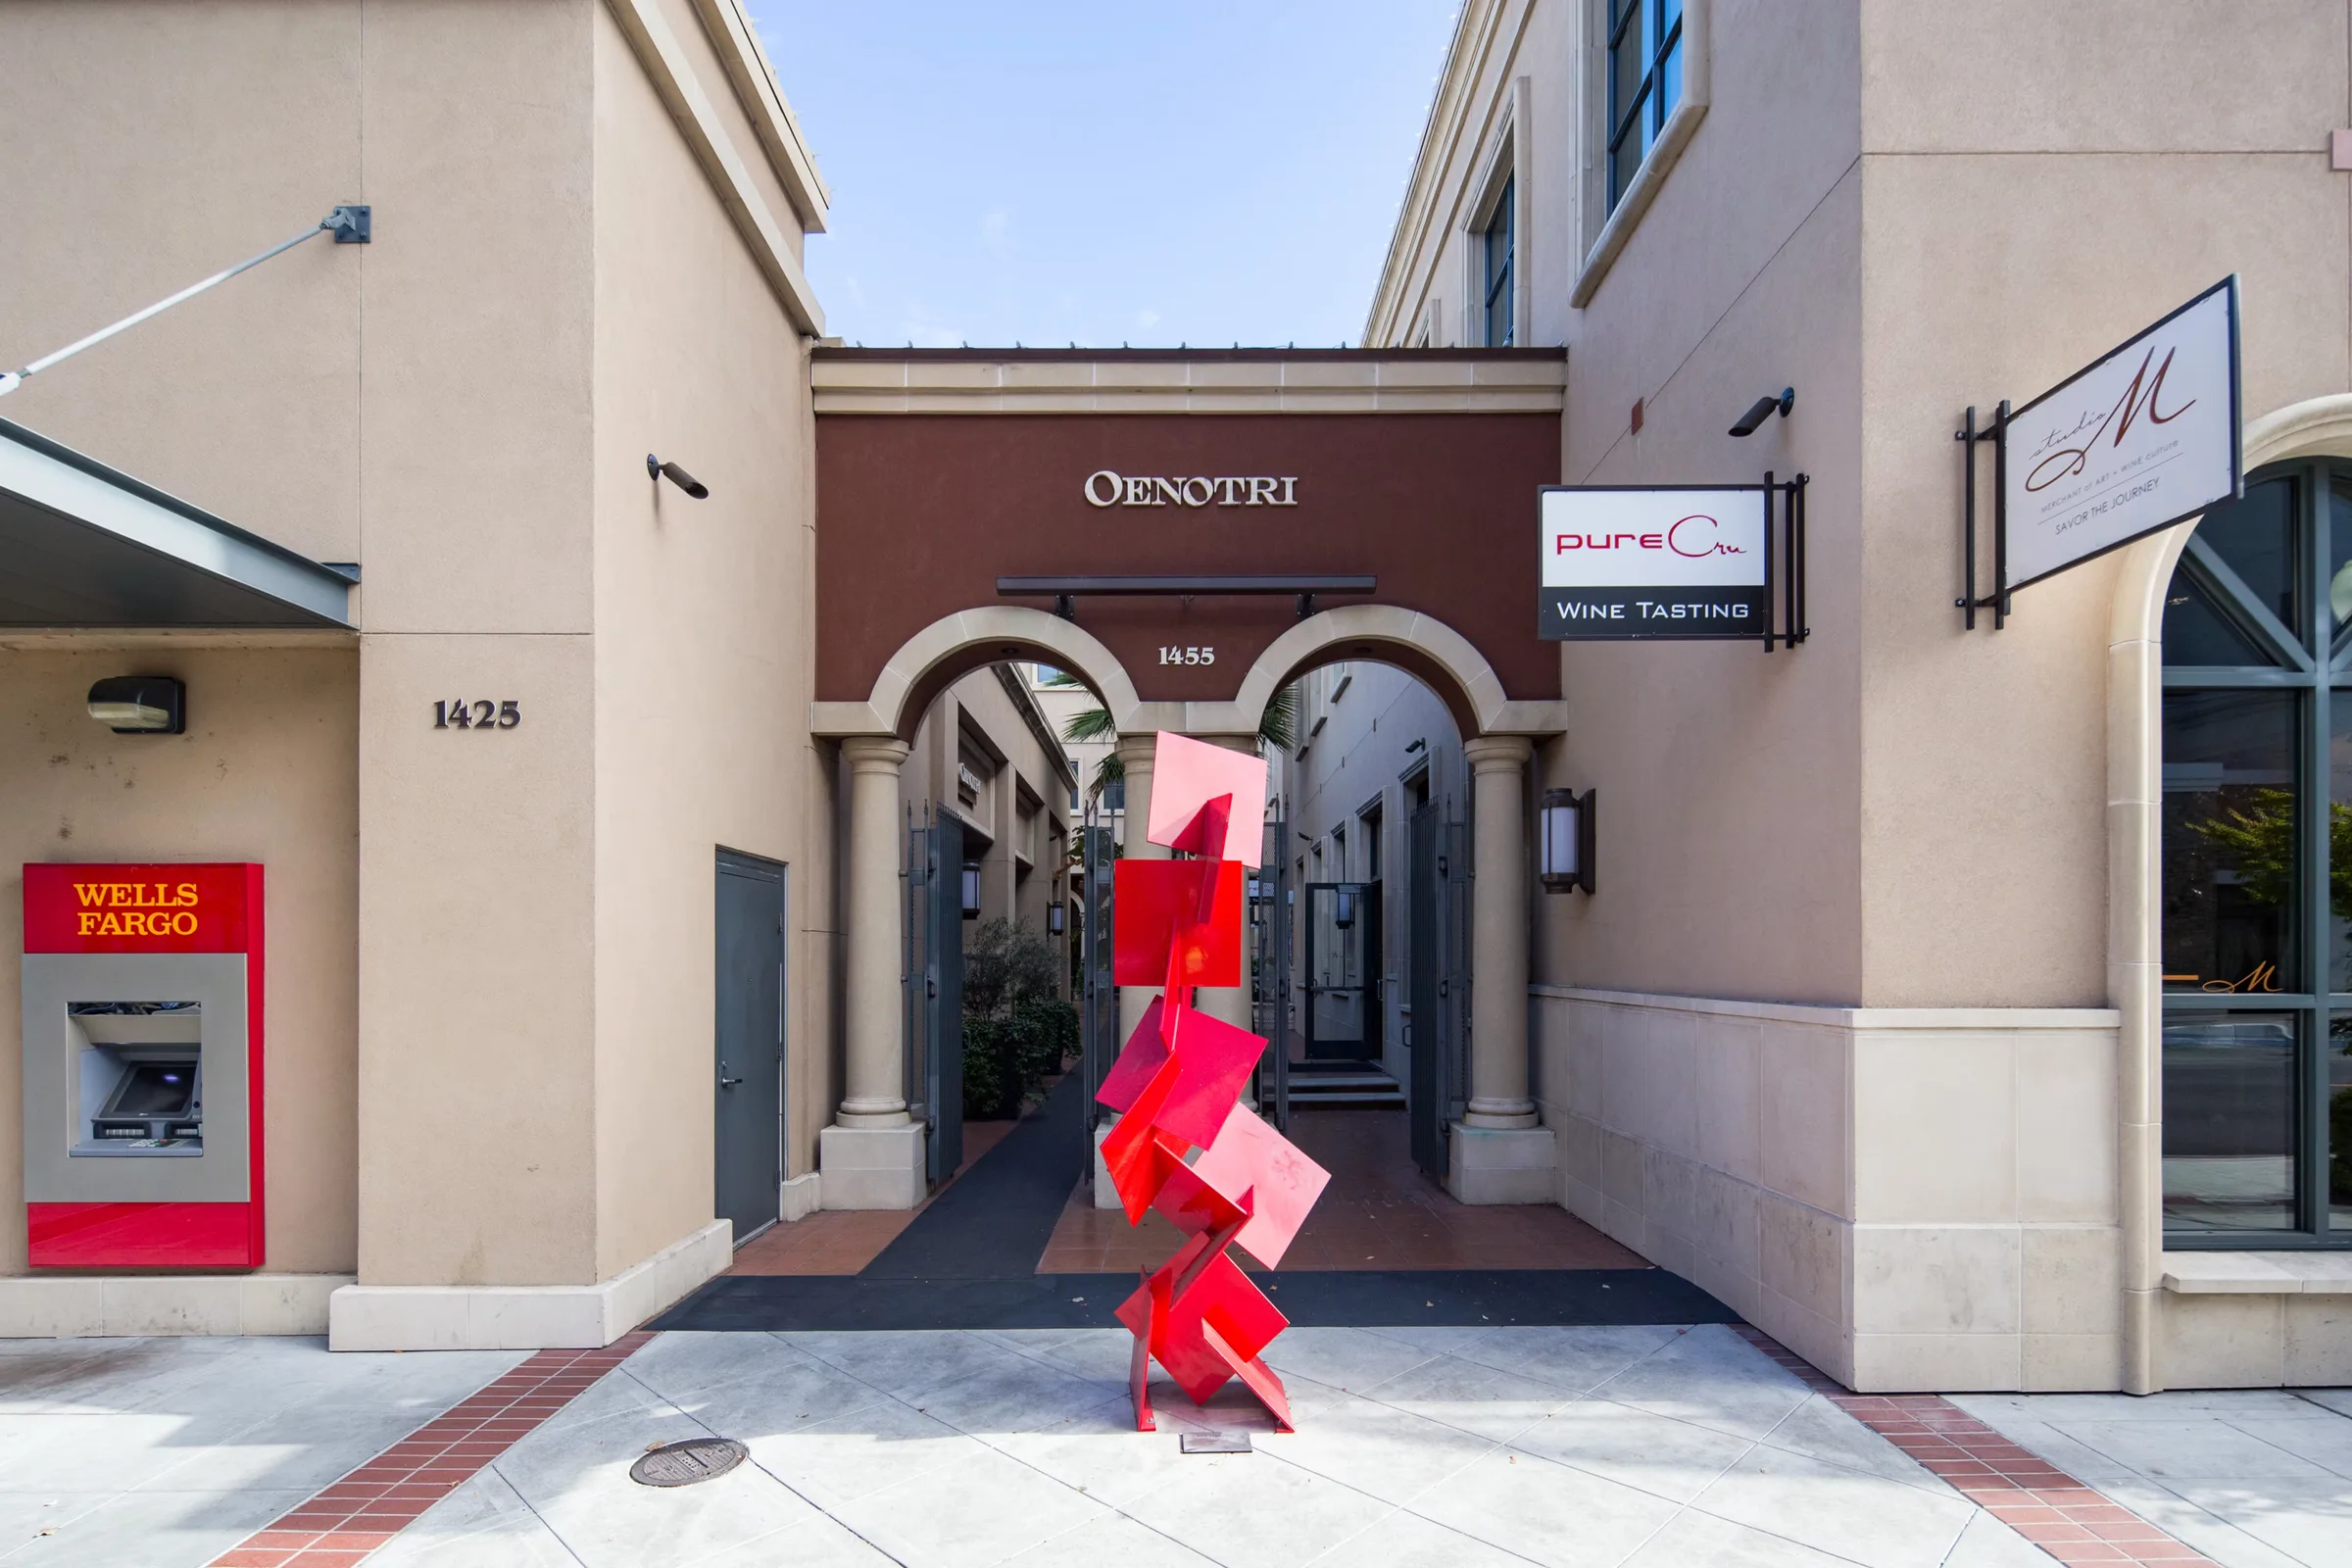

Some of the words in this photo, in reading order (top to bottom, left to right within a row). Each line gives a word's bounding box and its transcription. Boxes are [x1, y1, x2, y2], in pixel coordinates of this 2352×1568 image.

[2041, 487, 2082, 514] MERCHANT
[2095, 472, 2110, 485] ART
[2121, 456, 2143, 472] WINE
[2055, 511, 2088, 535] SAVOR
[2091, 501, 2108, 517] THE
[2111, 476, 2160, 510] JOURNEY
[1158, 646, 1215, 665] 1455
[433, 698, 523, 729] 1425
[74, 883, 199, 906] WELLS
[77, 911, 198, 936] FARGO
